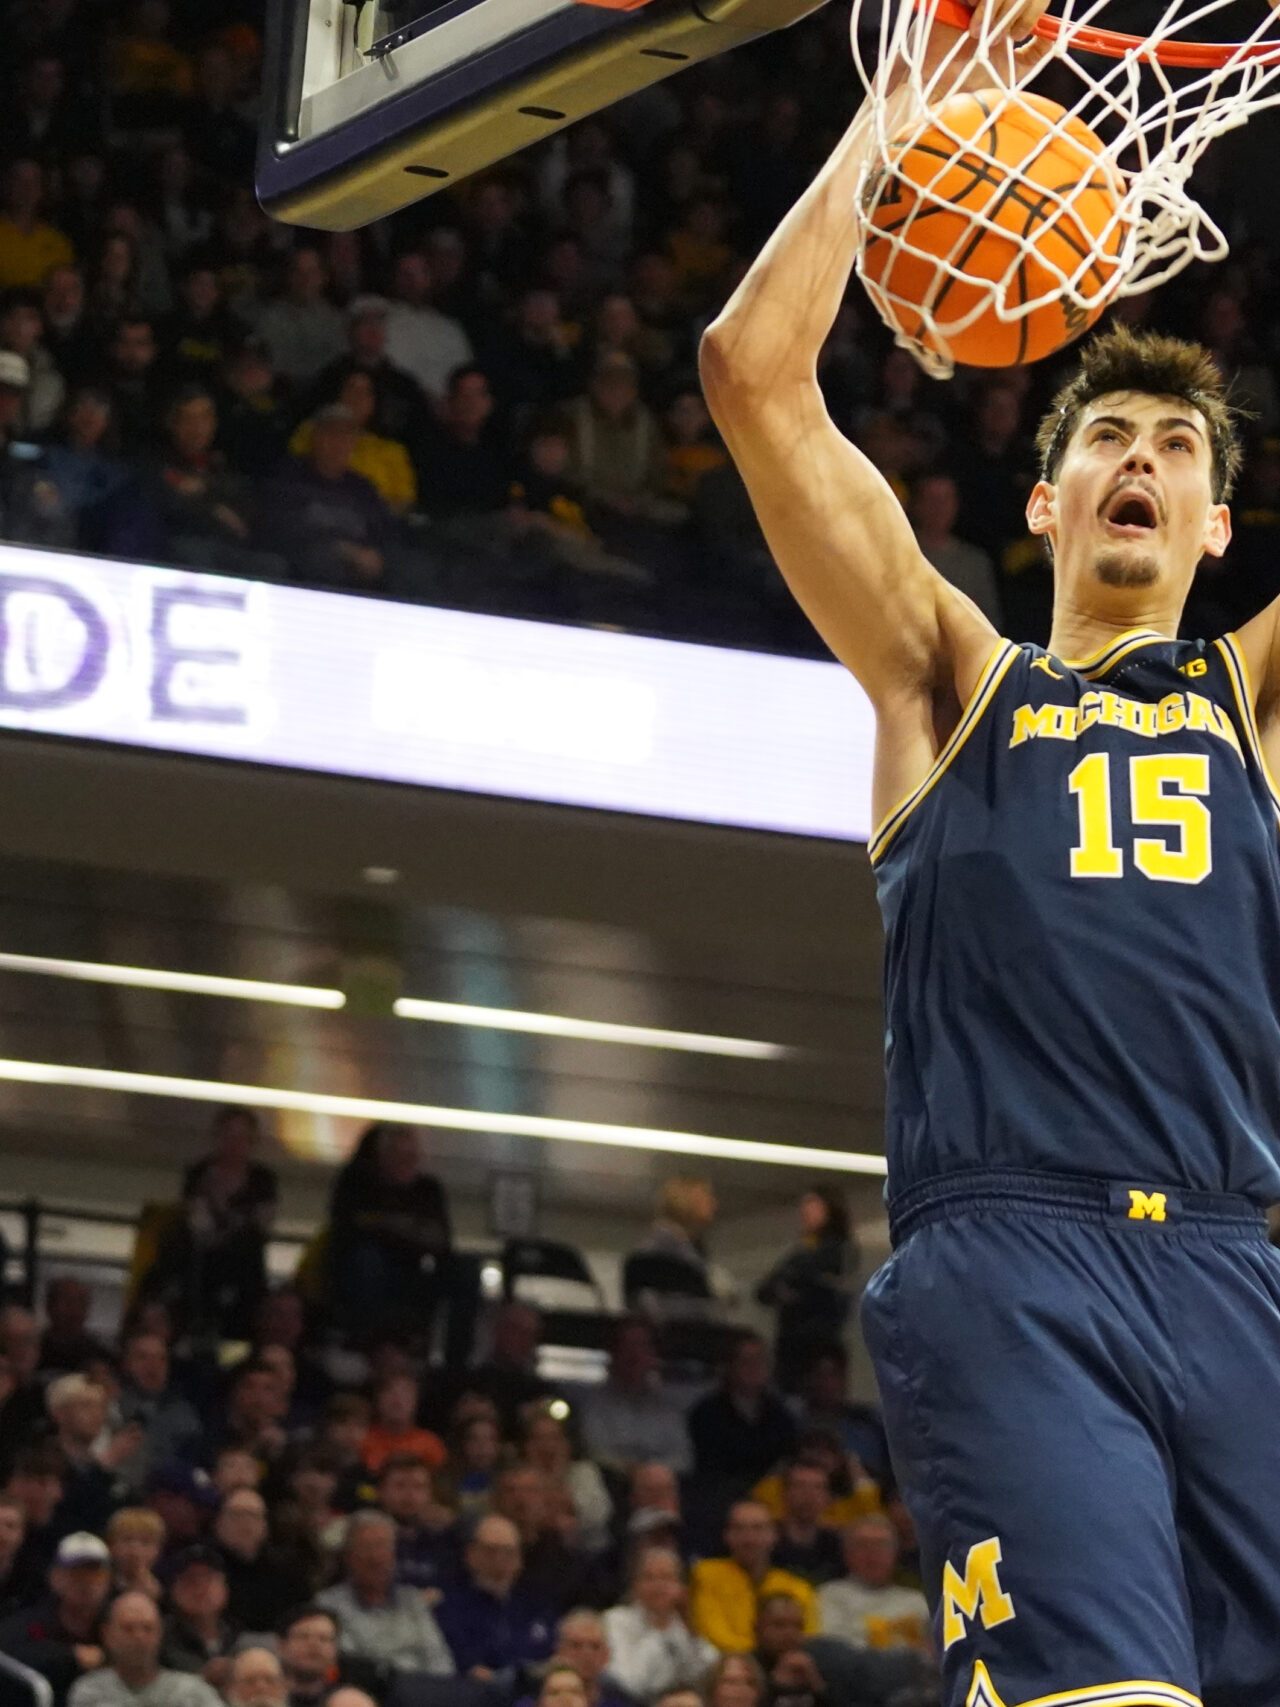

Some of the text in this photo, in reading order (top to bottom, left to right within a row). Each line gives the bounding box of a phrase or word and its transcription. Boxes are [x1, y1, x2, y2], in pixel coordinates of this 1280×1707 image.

[1068, 752, 1213, 885] 15
[1128, 1190, 1167, 1222] M
[943, 1536, 1016, 1651] M
